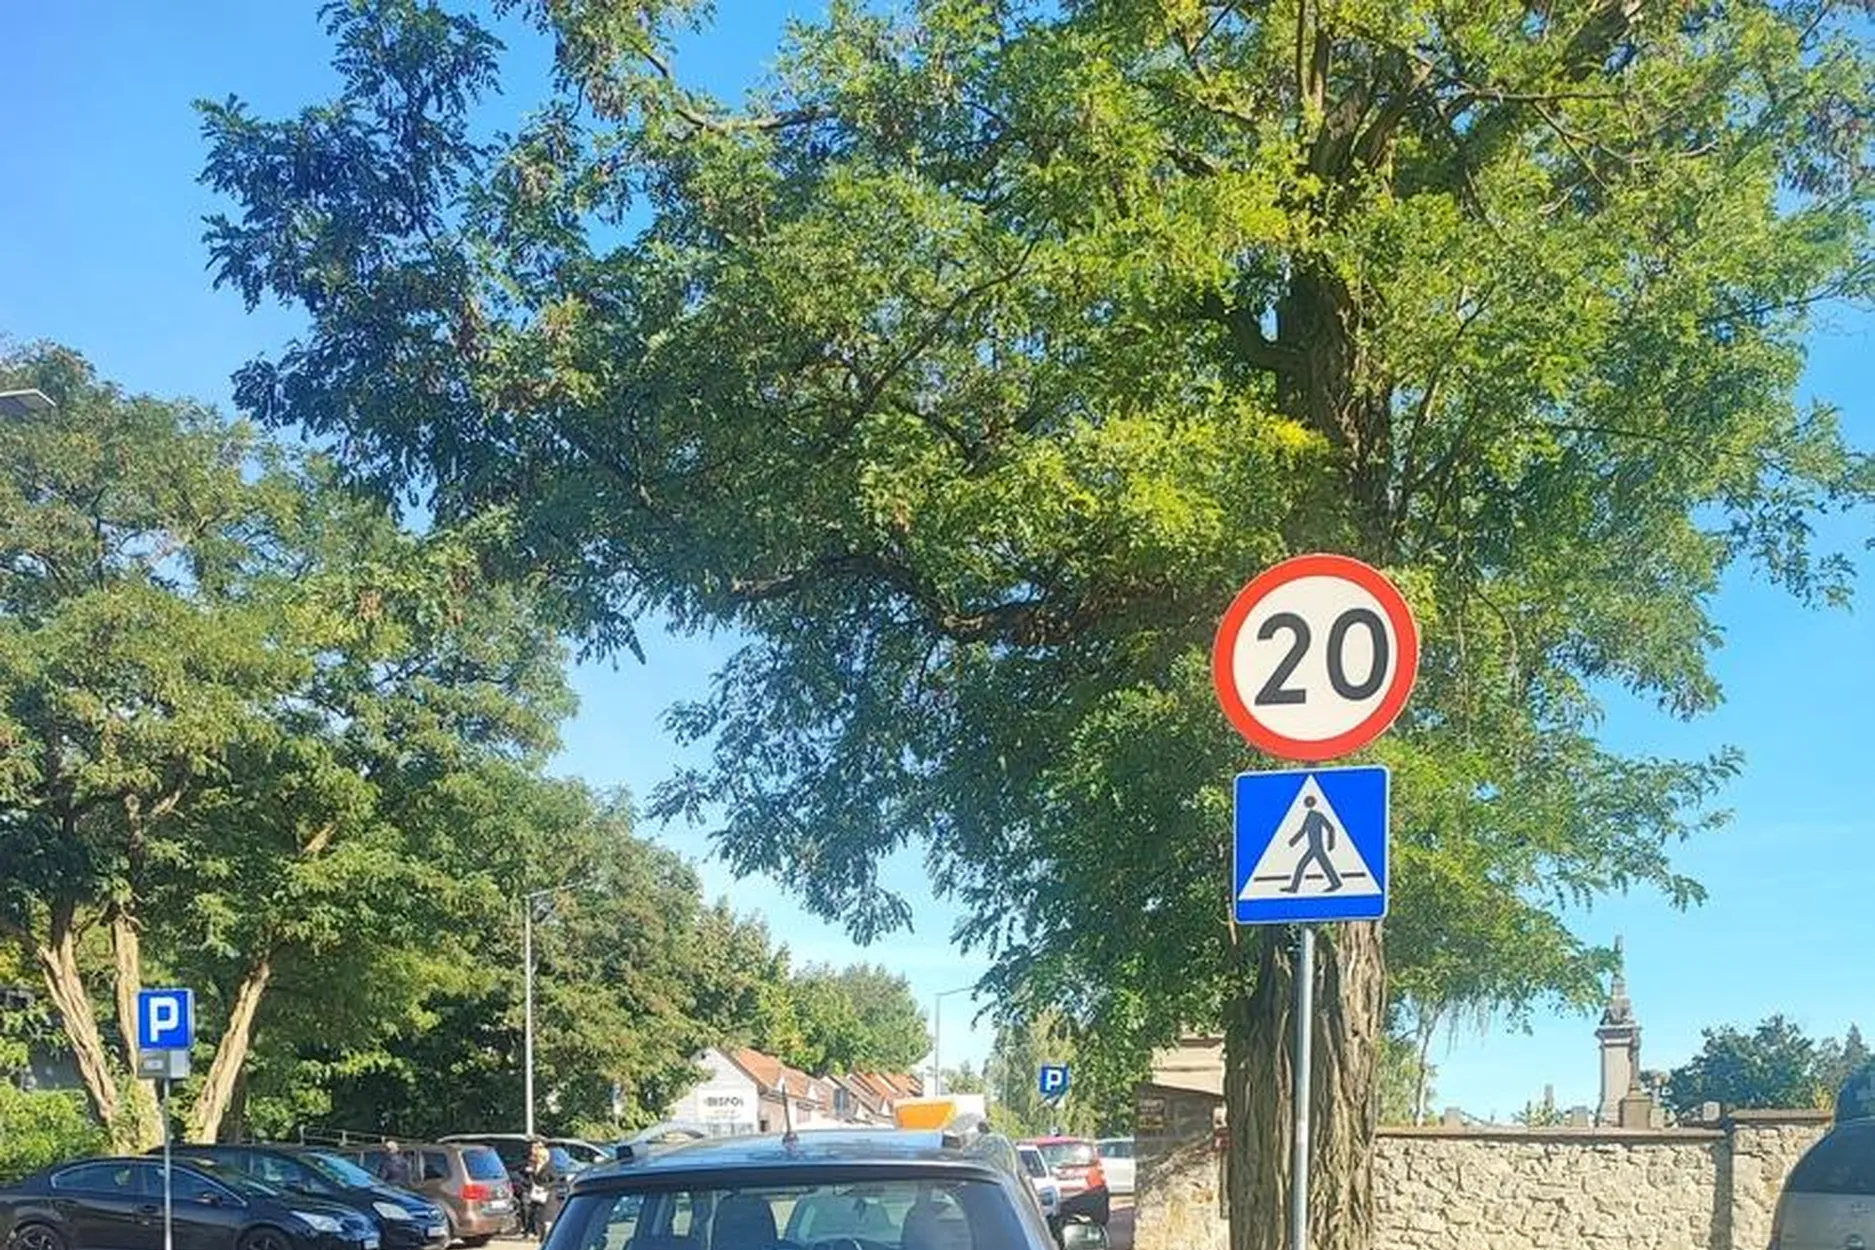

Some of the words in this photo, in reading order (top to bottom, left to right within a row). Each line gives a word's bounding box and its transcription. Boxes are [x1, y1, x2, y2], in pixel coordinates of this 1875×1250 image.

[1254, 607, 1390, 706] 20
[150, 996, 180, 1043] P
[1045, 1069, 1063, 1091] P
